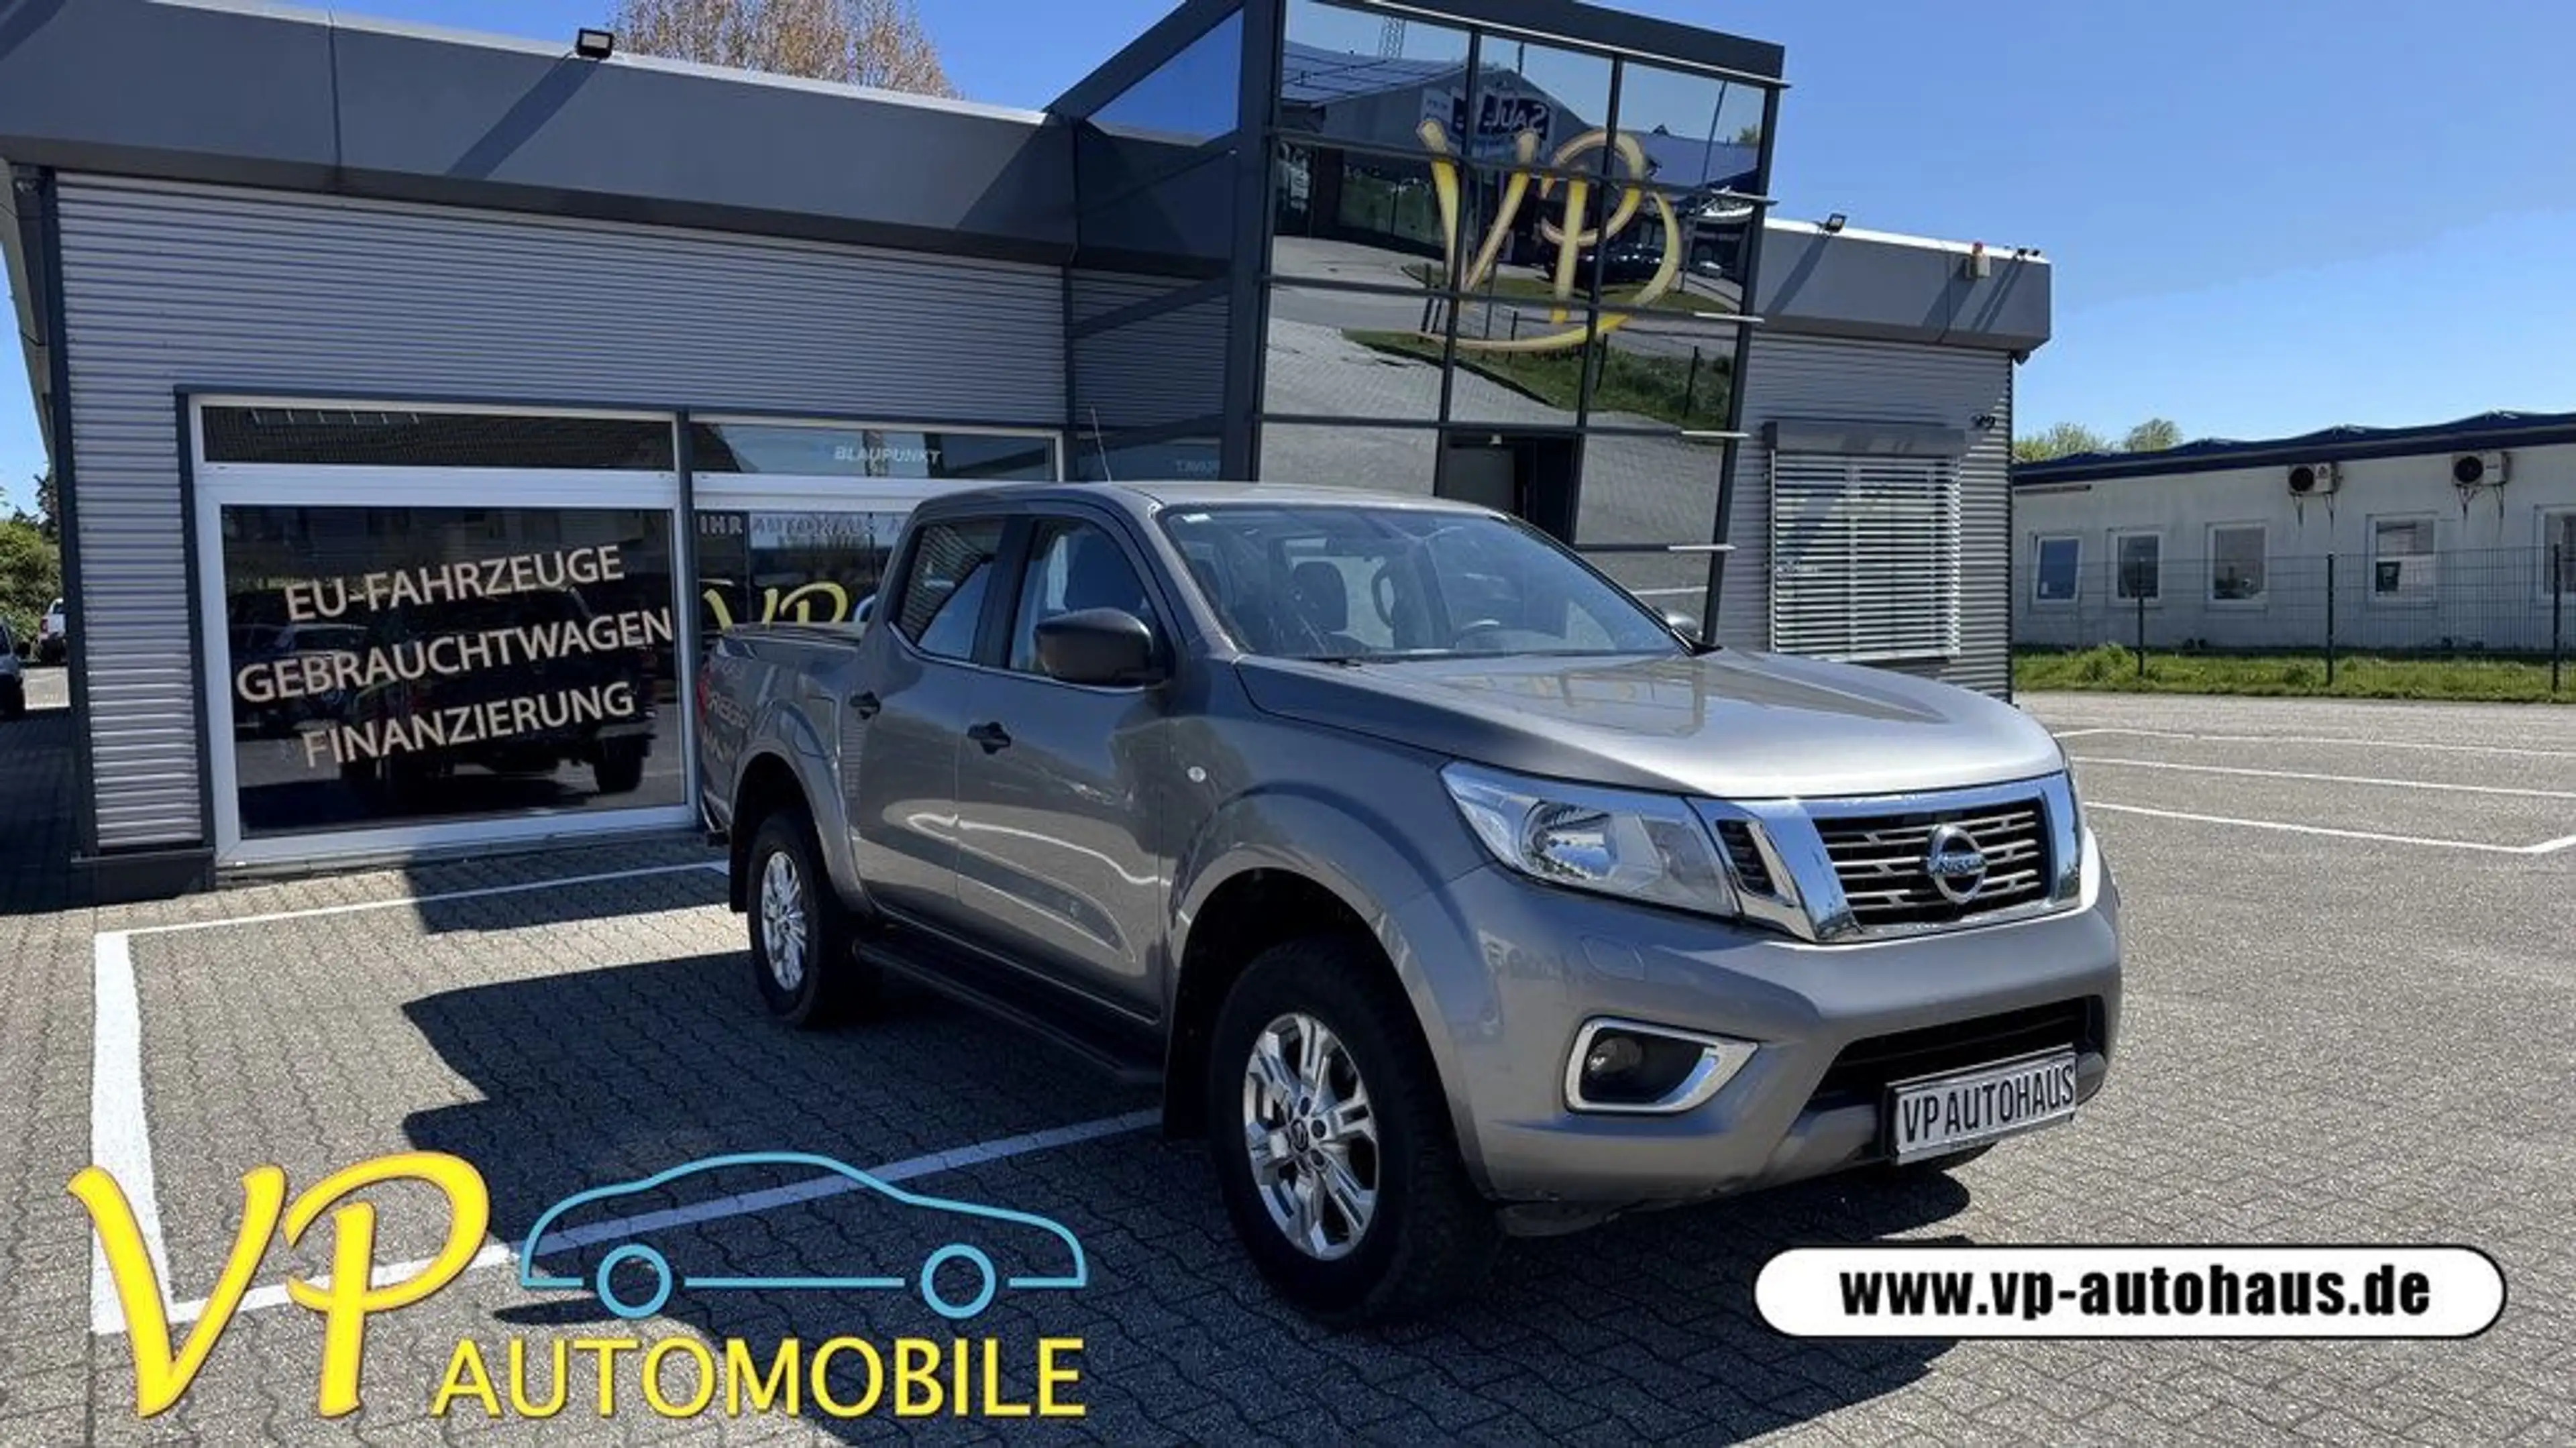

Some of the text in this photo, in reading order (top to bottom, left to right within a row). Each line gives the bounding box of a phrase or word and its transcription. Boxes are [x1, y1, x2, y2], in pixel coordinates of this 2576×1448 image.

[835, 445, 941, 465] BLAUPUNKT
[699, 514, 743, 535] IHR
[285, 544, 625, 622] EU-FAHRZEUGE
[236, 606, 674, 704] GEBRAUCHTWAGEN
[301, 680, 635, 769] FINANZIERUNG
[1903, 1064, 2074, 1143] VP AUTOHAUS
